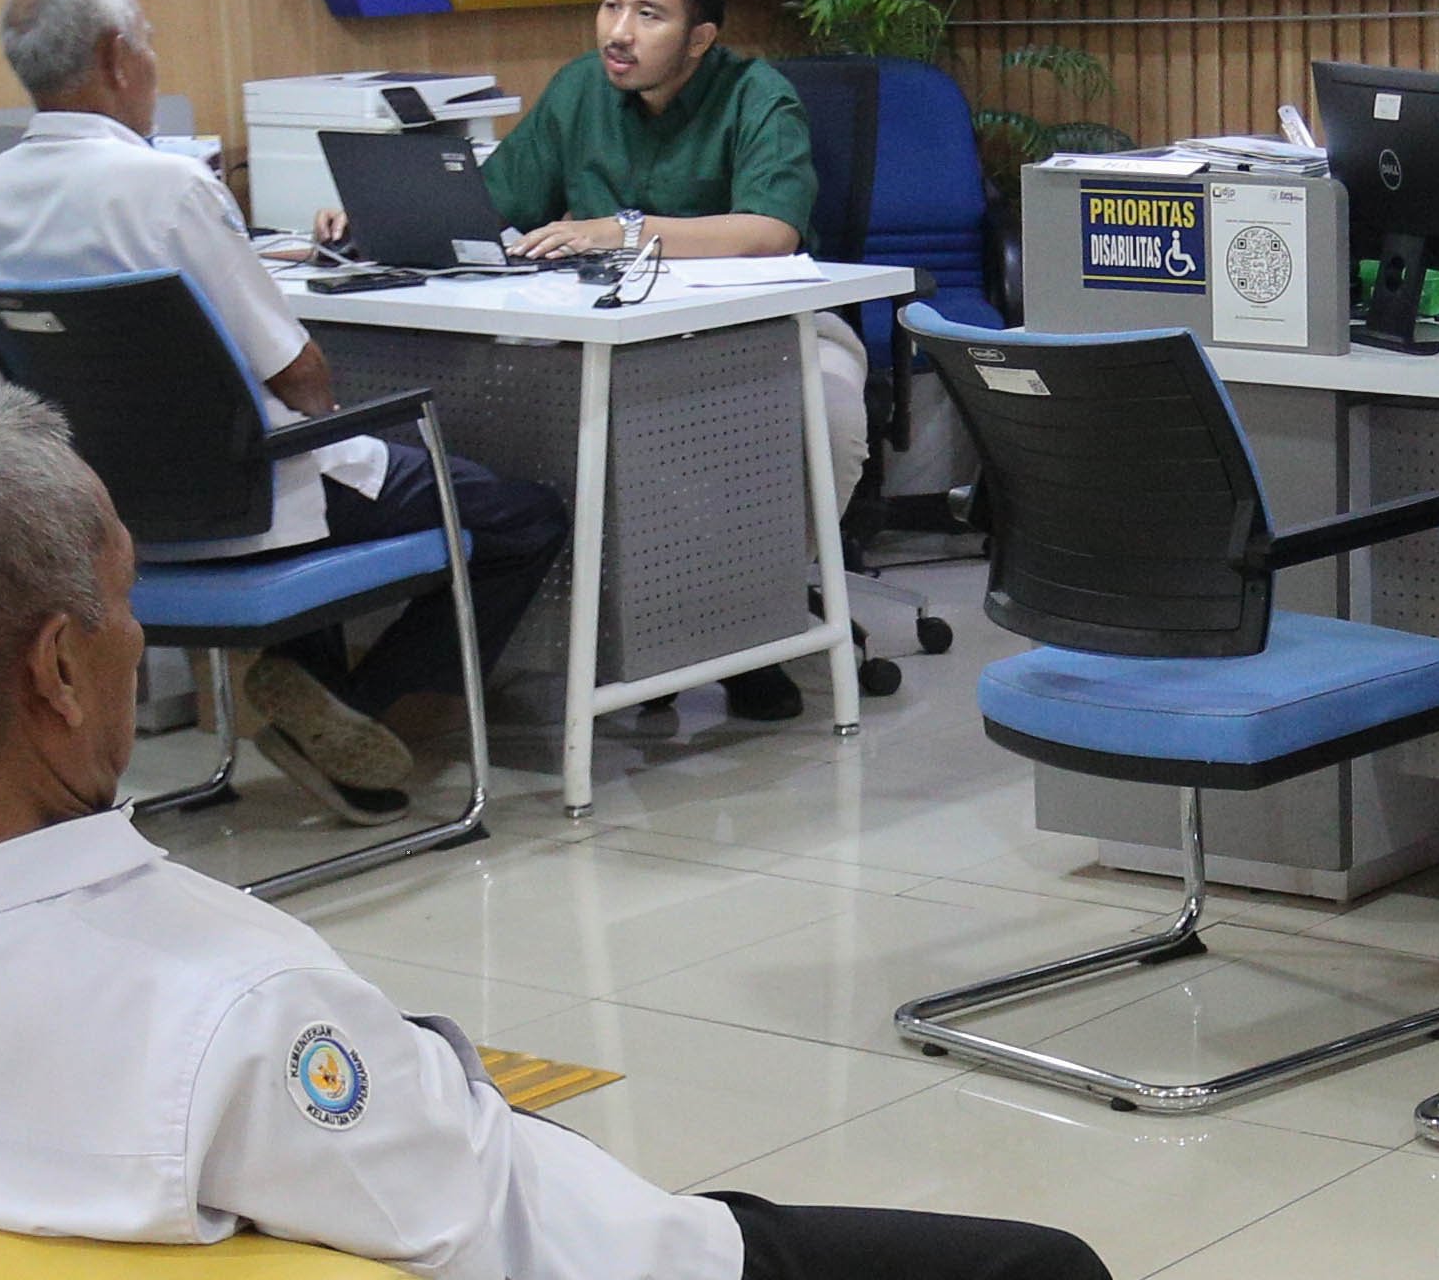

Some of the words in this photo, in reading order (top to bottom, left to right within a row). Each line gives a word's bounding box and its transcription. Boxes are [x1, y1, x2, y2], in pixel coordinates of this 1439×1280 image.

[1089, 198, 1196, 228] PRIORITAS
[1090, 233, 1162, 269] DISABILITAS
[291, 1025, 332, 1078] KEMENTERIAN
[306, 1104, 348, 1125] KELAUTAN
